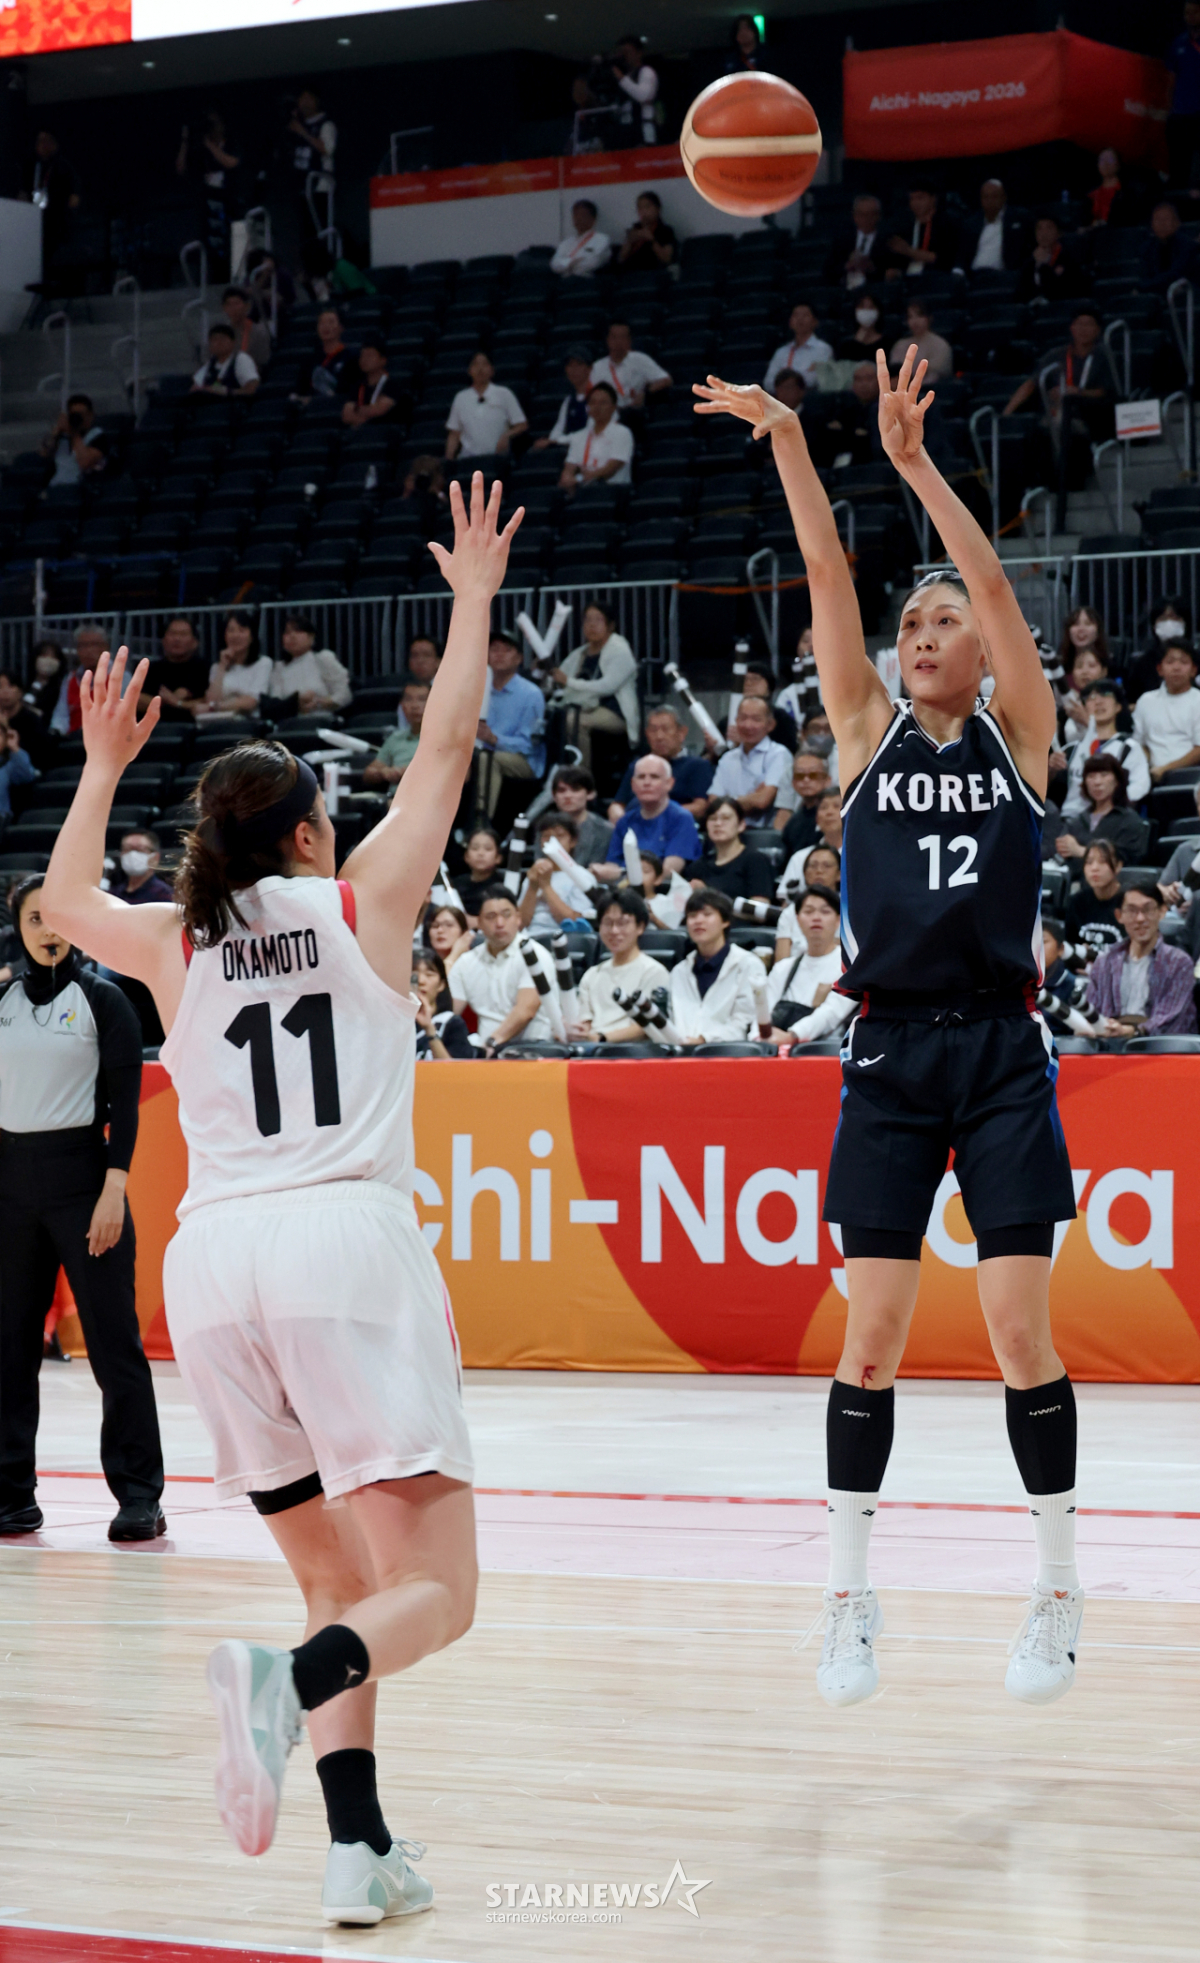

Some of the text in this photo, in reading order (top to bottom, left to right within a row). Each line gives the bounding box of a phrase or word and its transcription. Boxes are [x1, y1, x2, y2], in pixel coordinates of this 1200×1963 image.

[984, 81, 1026, 101] 2026
[876, 767, 1013, 813] KOREA
[917, 834, 979, 890] 12
[222, 928, 319, 981] OKAMOTO
[224, 992, 341, 1137] 11
